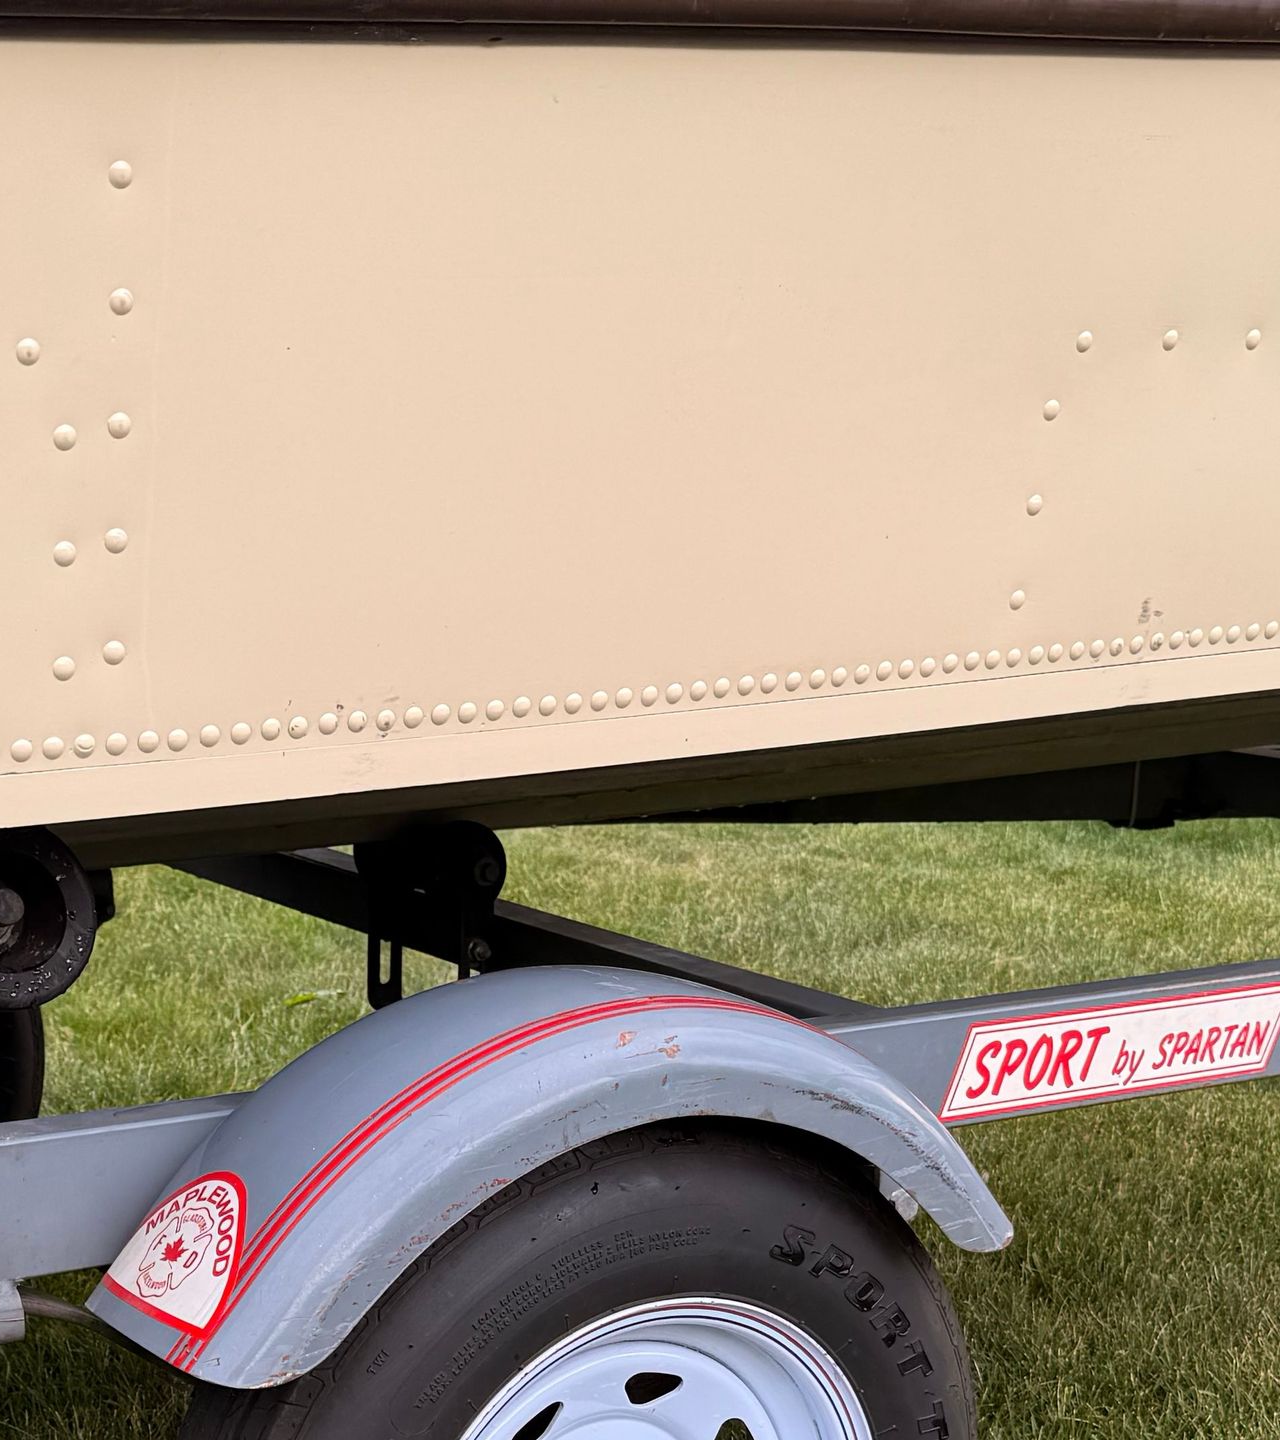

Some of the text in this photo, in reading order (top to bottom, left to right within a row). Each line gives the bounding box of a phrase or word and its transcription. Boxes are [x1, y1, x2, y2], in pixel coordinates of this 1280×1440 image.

[965, 1020, 1271, 1099] SPORT by SPARTAN
[145, 1185, 235, 1278] MAPLEWOOD
[152, 1233, 167, 1251] F
[182, 1250, 199, 1269] D
[769, 1223, 934, 1378] SPORT
[366, 1349, 390, 1375] TWI
